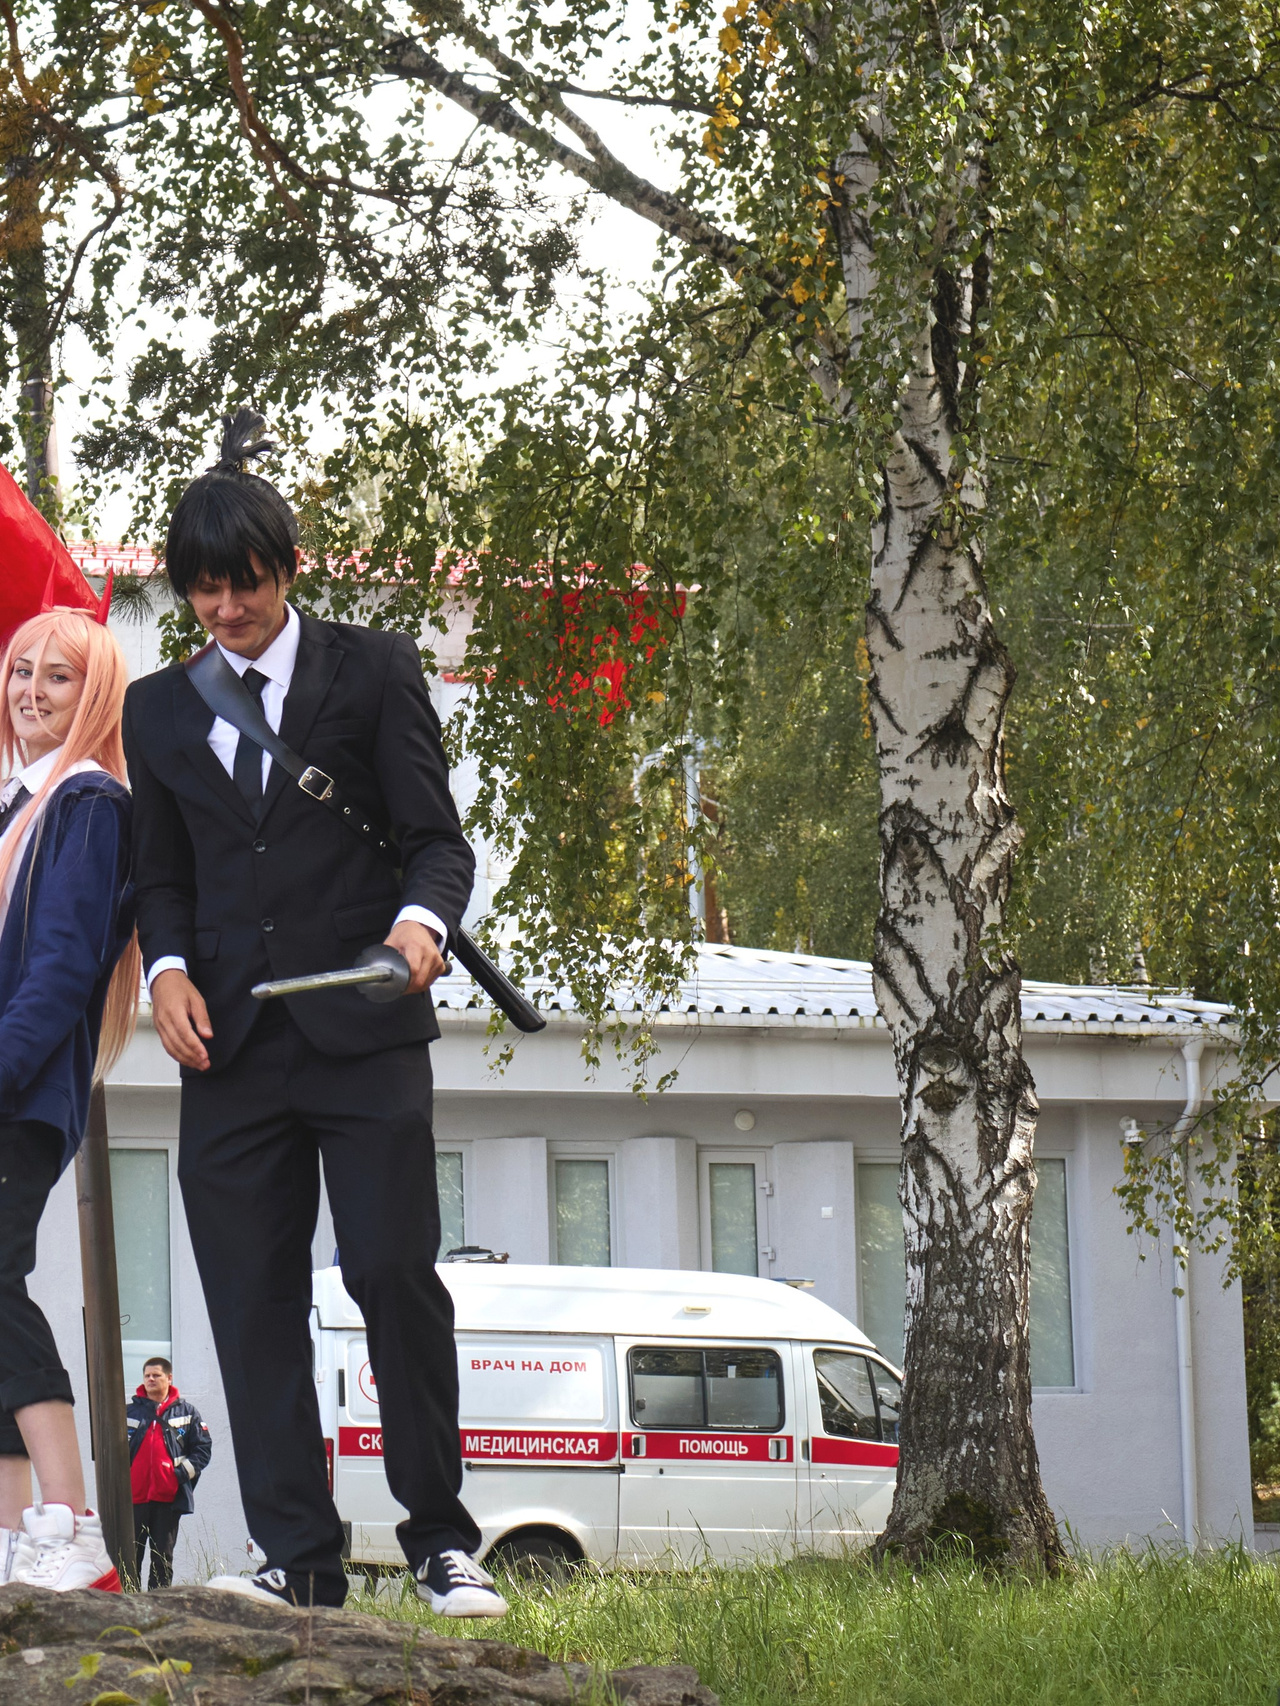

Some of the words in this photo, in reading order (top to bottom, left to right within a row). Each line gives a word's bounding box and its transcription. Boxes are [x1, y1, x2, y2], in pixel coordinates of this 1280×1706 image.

[470, 1359, 516, 1371] ВРАЧ
[521, 1360, 545, 1371] НА
[549, 1361, 587, 1373] ДОМ
[465, 1435, 600, 1457] МЕДИЦИНСКАЯ
[678, 1439, 749, 1457] ПОМОЩЬ
